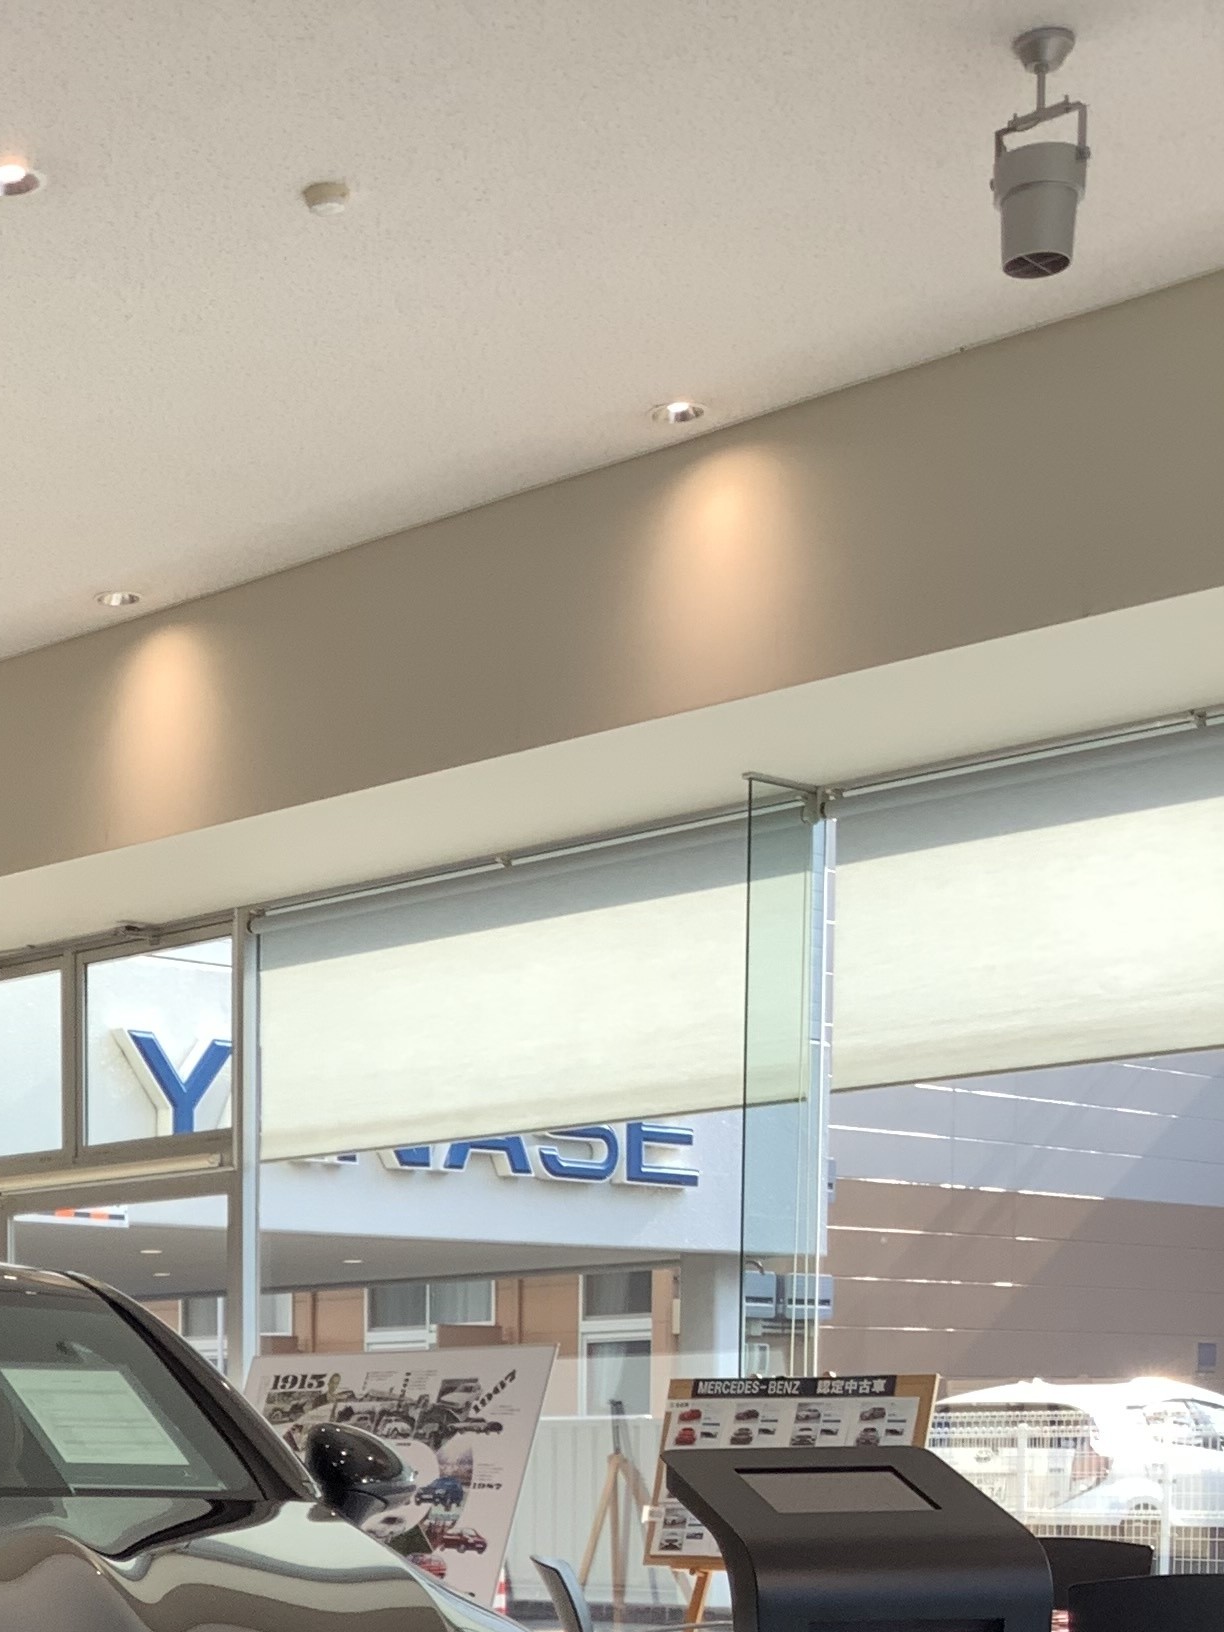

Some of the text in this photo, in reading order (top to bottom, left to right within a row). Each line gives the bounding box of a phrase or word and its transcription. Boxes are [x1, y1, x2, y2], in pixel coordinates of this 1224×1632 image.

[271, 1373, 328, 1391] 1915
[697, 1379, 886, 1395] MERCEDES-BENZ 認定中古車
